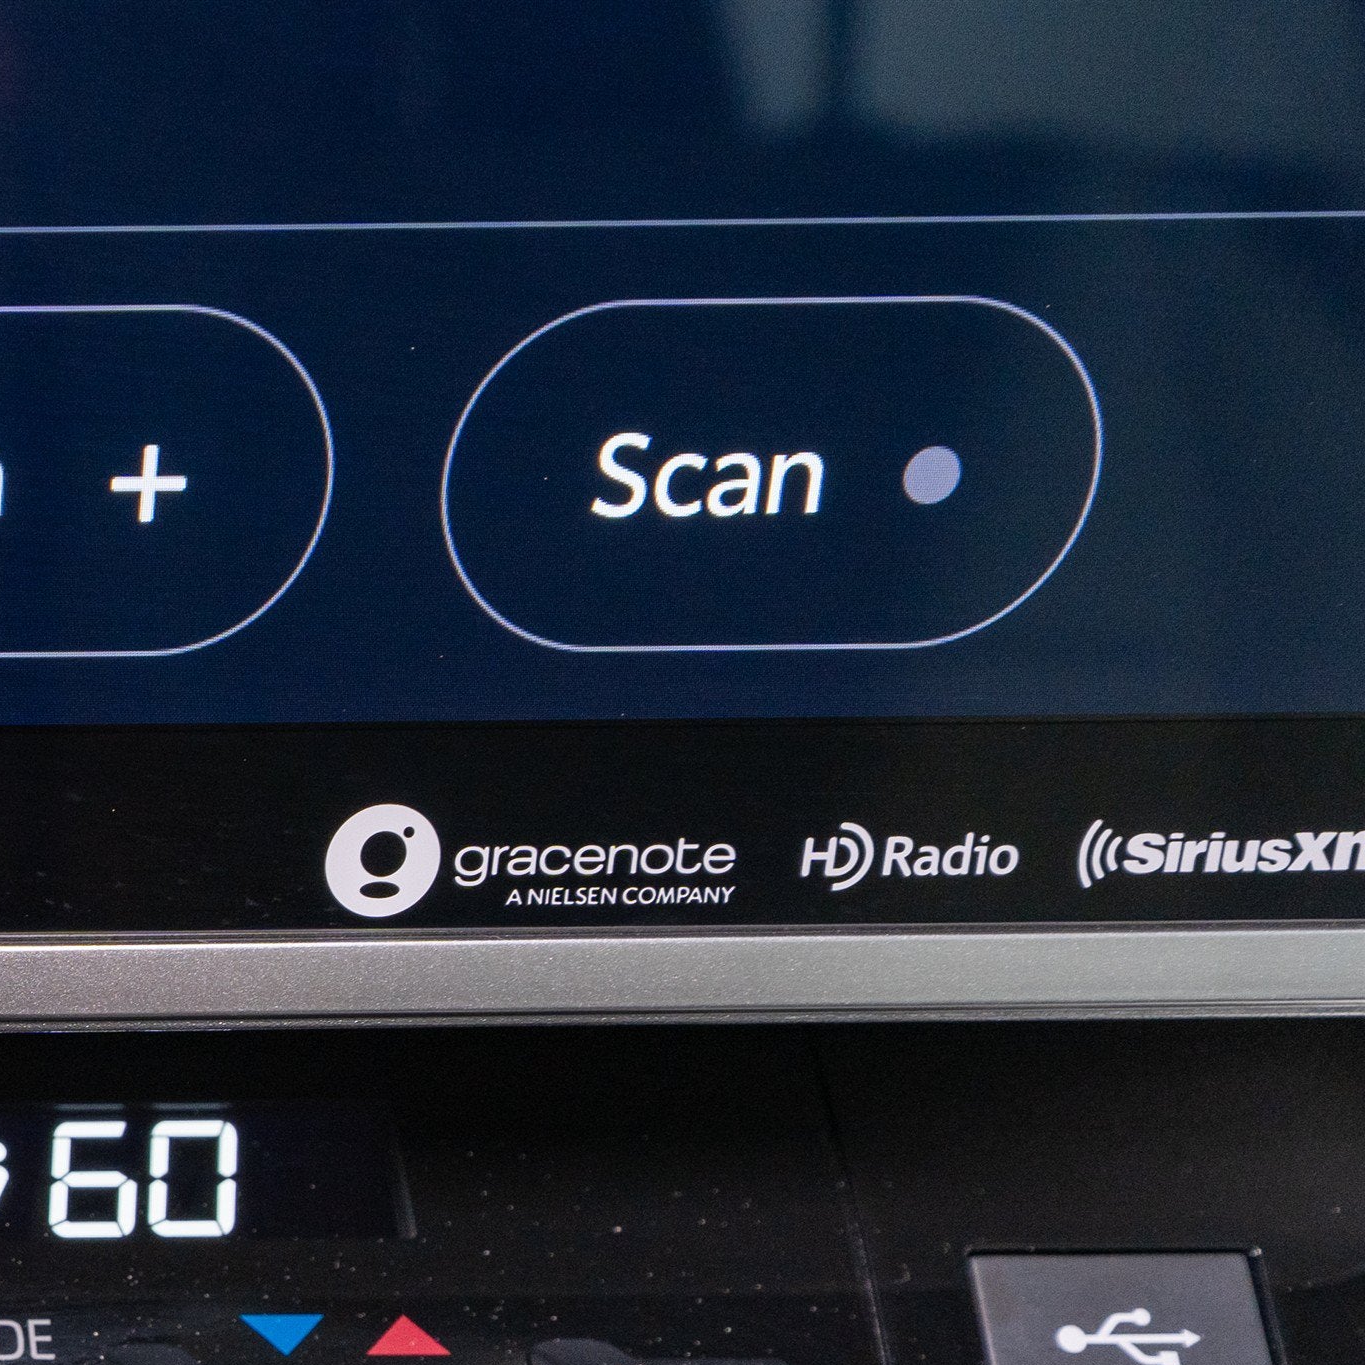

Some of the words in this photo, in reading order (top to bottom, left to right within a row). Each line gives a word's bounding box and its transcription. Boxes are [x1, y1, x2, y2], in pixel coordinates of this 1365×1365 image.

[591, 432, 825, 520] Scan
[454, 837, 737, 887] gracenote
[881, 832, 1020, 877] Radio
[505, 889, 524, 907] A
[527, 886, 619, 906] NIELSEN
[622, 885, 737, 906] COMPANY
[48, 1119, 240, 1240] 60
